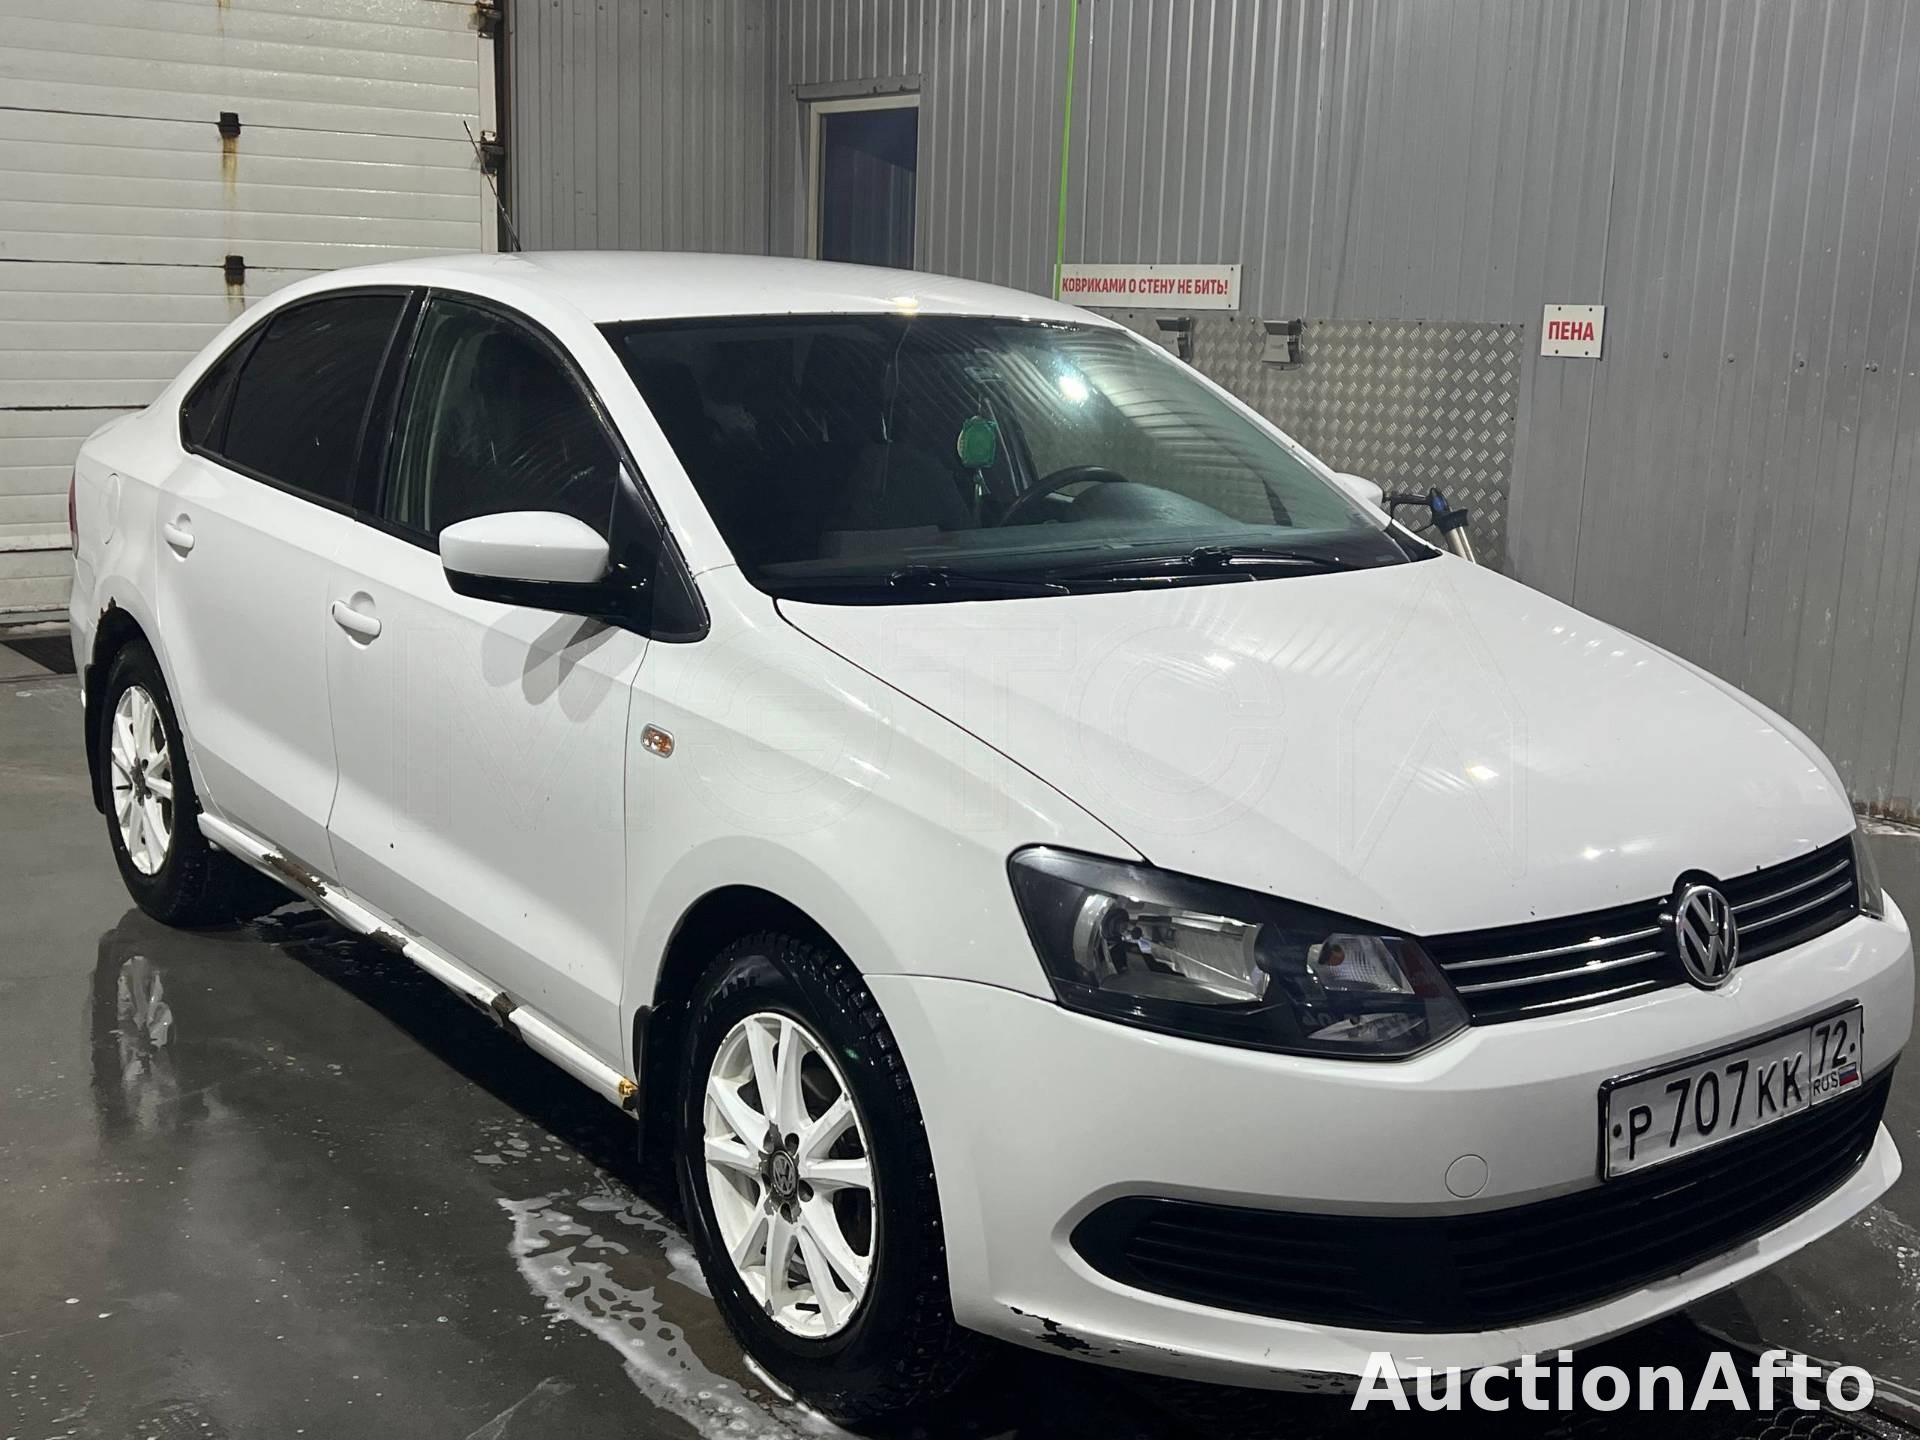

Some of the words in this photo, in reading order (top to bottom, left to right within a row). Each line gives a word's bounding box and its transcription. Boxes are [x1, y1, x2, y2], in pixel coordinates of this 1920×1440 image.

[1062, 277, 1126, 293] КОВРИКАМИ
[1128, 278, 1136, 293] О
[1138, 278, 1176, 294] СТЕНУ
[1177, 279, 1192, 294] НЕ
[1194, 279, 1229, 295] БИТЬ!
[1548, 320, 1595, 341] ПЕНА
[1814, 1019, 1848, 1076] 72
[1812, 1074, 1839, 1097] RUS
